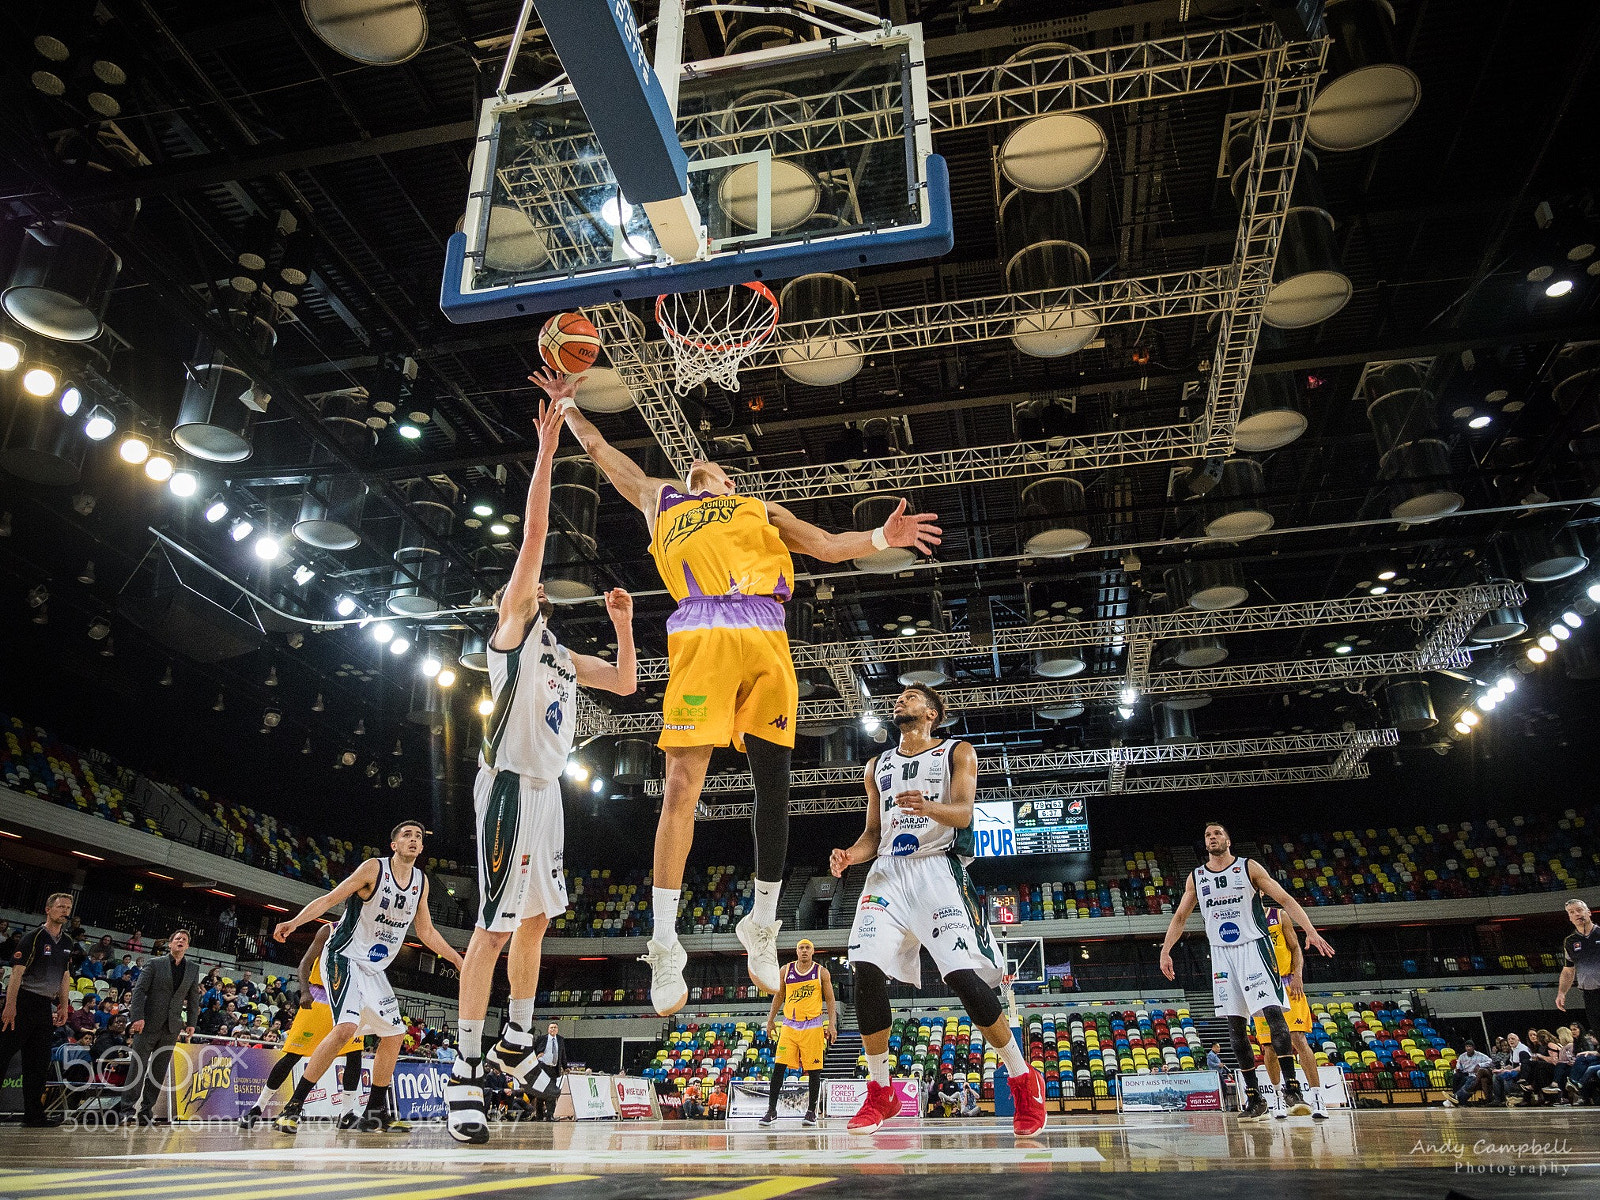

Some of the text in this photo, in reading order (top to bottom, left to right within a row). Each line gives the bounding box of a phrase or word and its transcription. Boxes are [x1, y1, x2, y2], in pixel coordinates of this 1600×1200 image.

[703, 499, 736, 509] LONDON
[902, 761, 920, 780] 10
[394, 893, 407, 909] 13
[1000, 907, 1014, 923] 16
[211, 1056, 233, 1068] LONDON
[398, 1067, 450, 1100] molte
[411, 1102, 421, 1114] For
[422, 1101, 433, 1112] the
